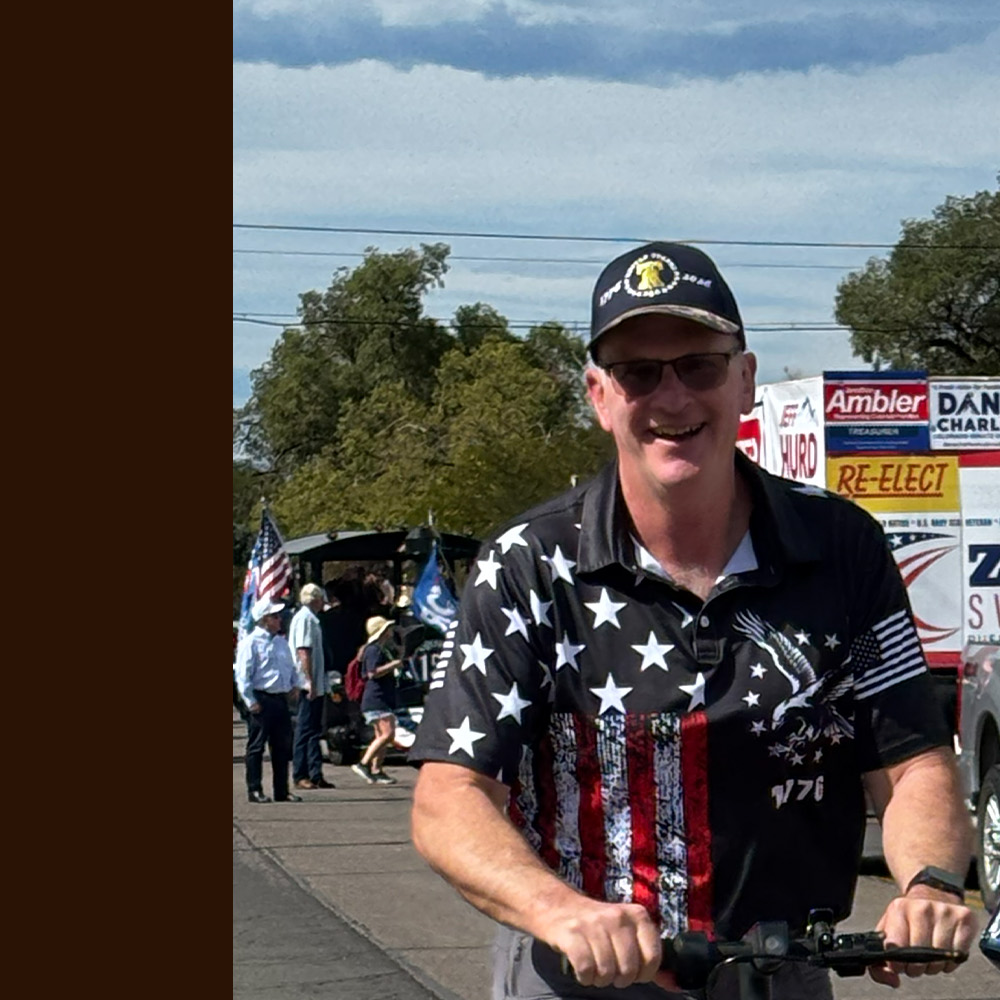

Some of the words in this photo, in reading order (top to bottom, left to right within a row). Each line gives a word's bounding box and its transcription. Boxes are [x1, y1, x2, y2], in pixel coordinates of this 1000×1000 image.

[825, 388, 926, 414] Ambler
[780, 432, 817, 478] HURD
[838, 463, 948, 493] RE-ELECT
